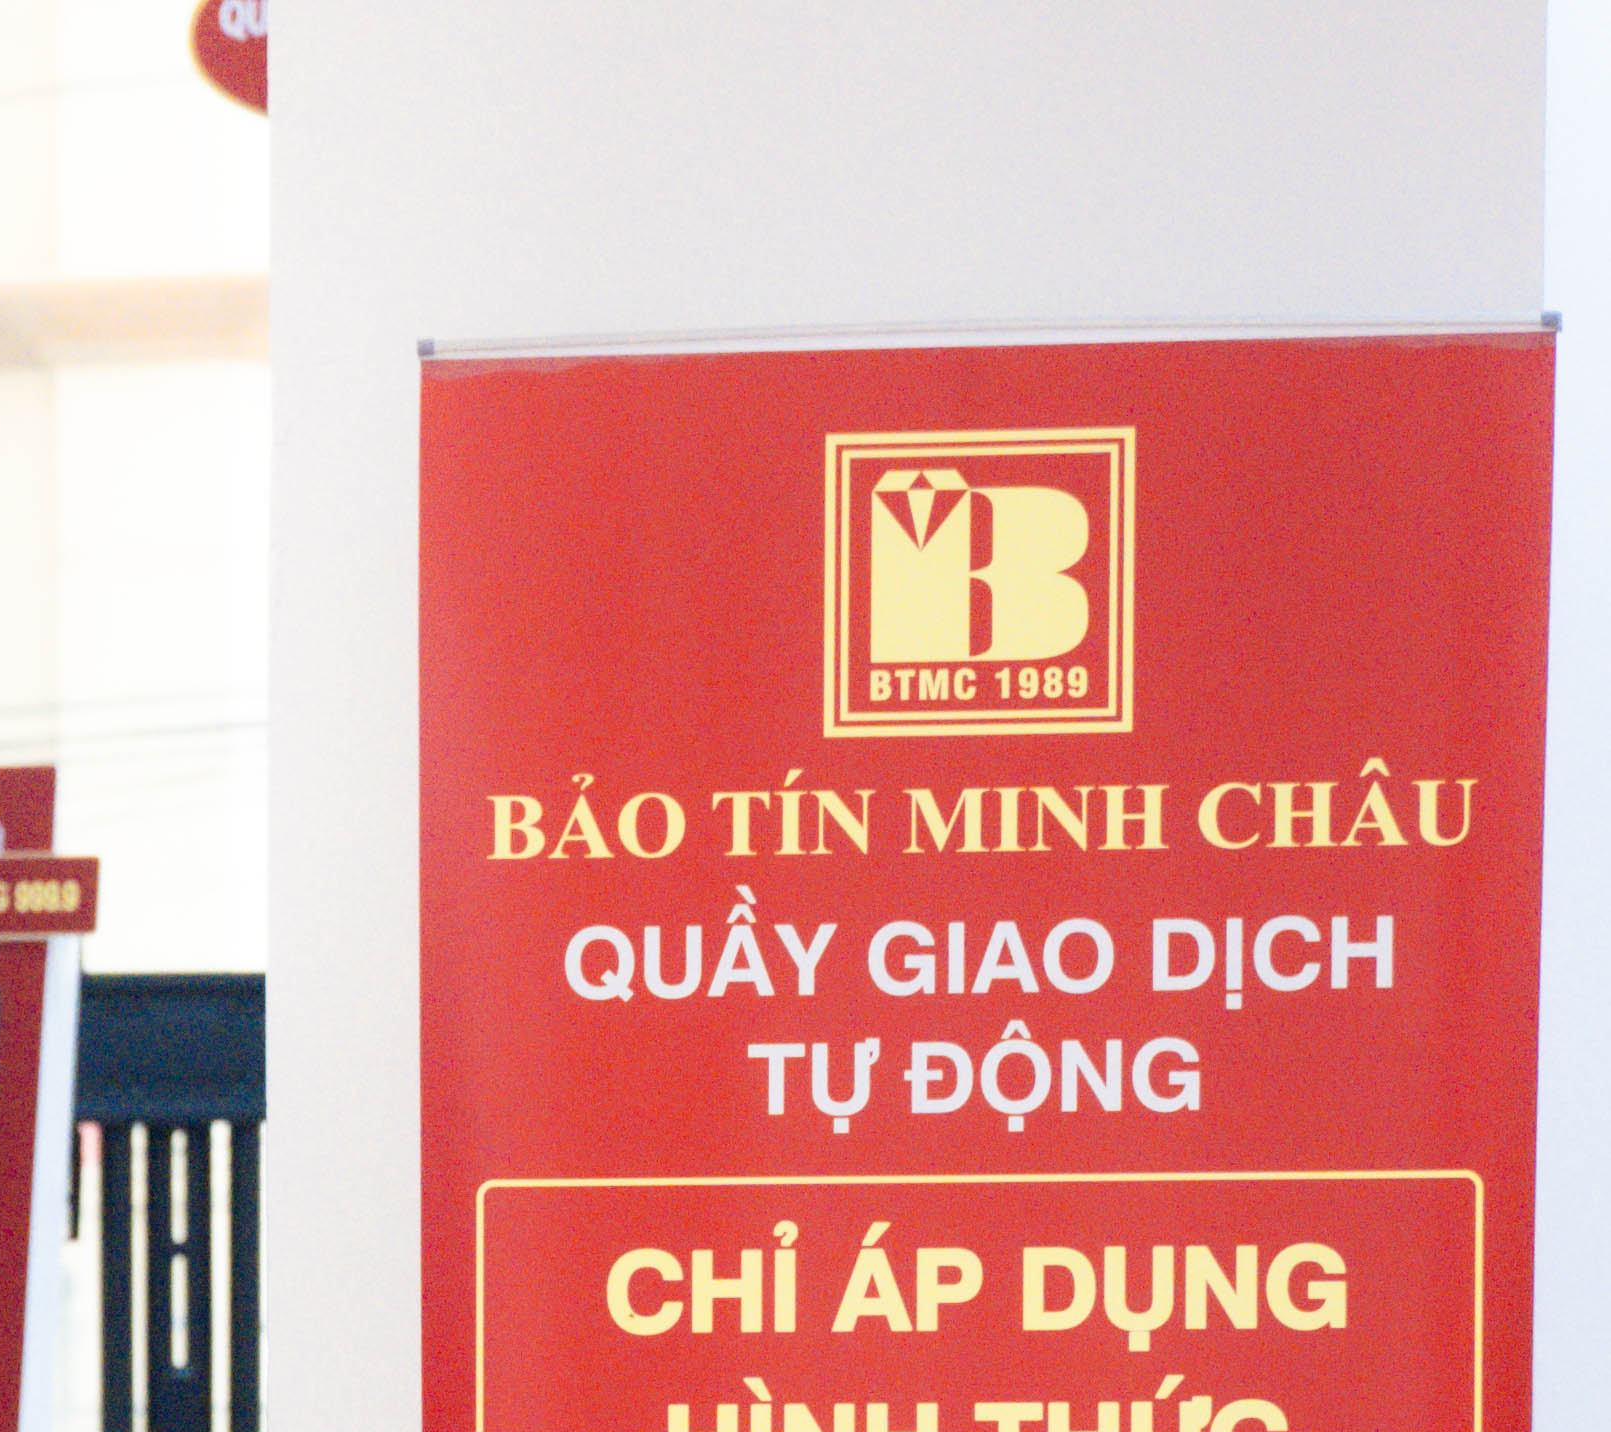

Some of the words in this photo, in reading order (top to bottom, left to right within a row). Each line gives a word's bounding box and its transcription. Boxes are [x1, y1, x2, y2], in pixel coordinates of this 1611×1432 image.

[870, 669, 977, 701] BTMC
[995, 665, 1089, 699] 1989
[487, 773, 685, 860] BẢO
[713, 770, 875, 857] TÍN
[903, 784, 1166, 853] MINH
[1197, 758, 1479, 849] CHÂU
[563, 885, 837, 1001] QUẦY
[868, 918, 1116, 997] GIAO
[1152, 914, 1396, 1009] DỊCH
[748, 1038, 880, 1134] TỰ
[904, 1019, 1202, 1132] ĐỘNG
[606, 1219, 798, 1336] CHỈ
[832, 1221, 984, 1332] ÁP
[1021, 1243, 1348, 1352] DỤNG
